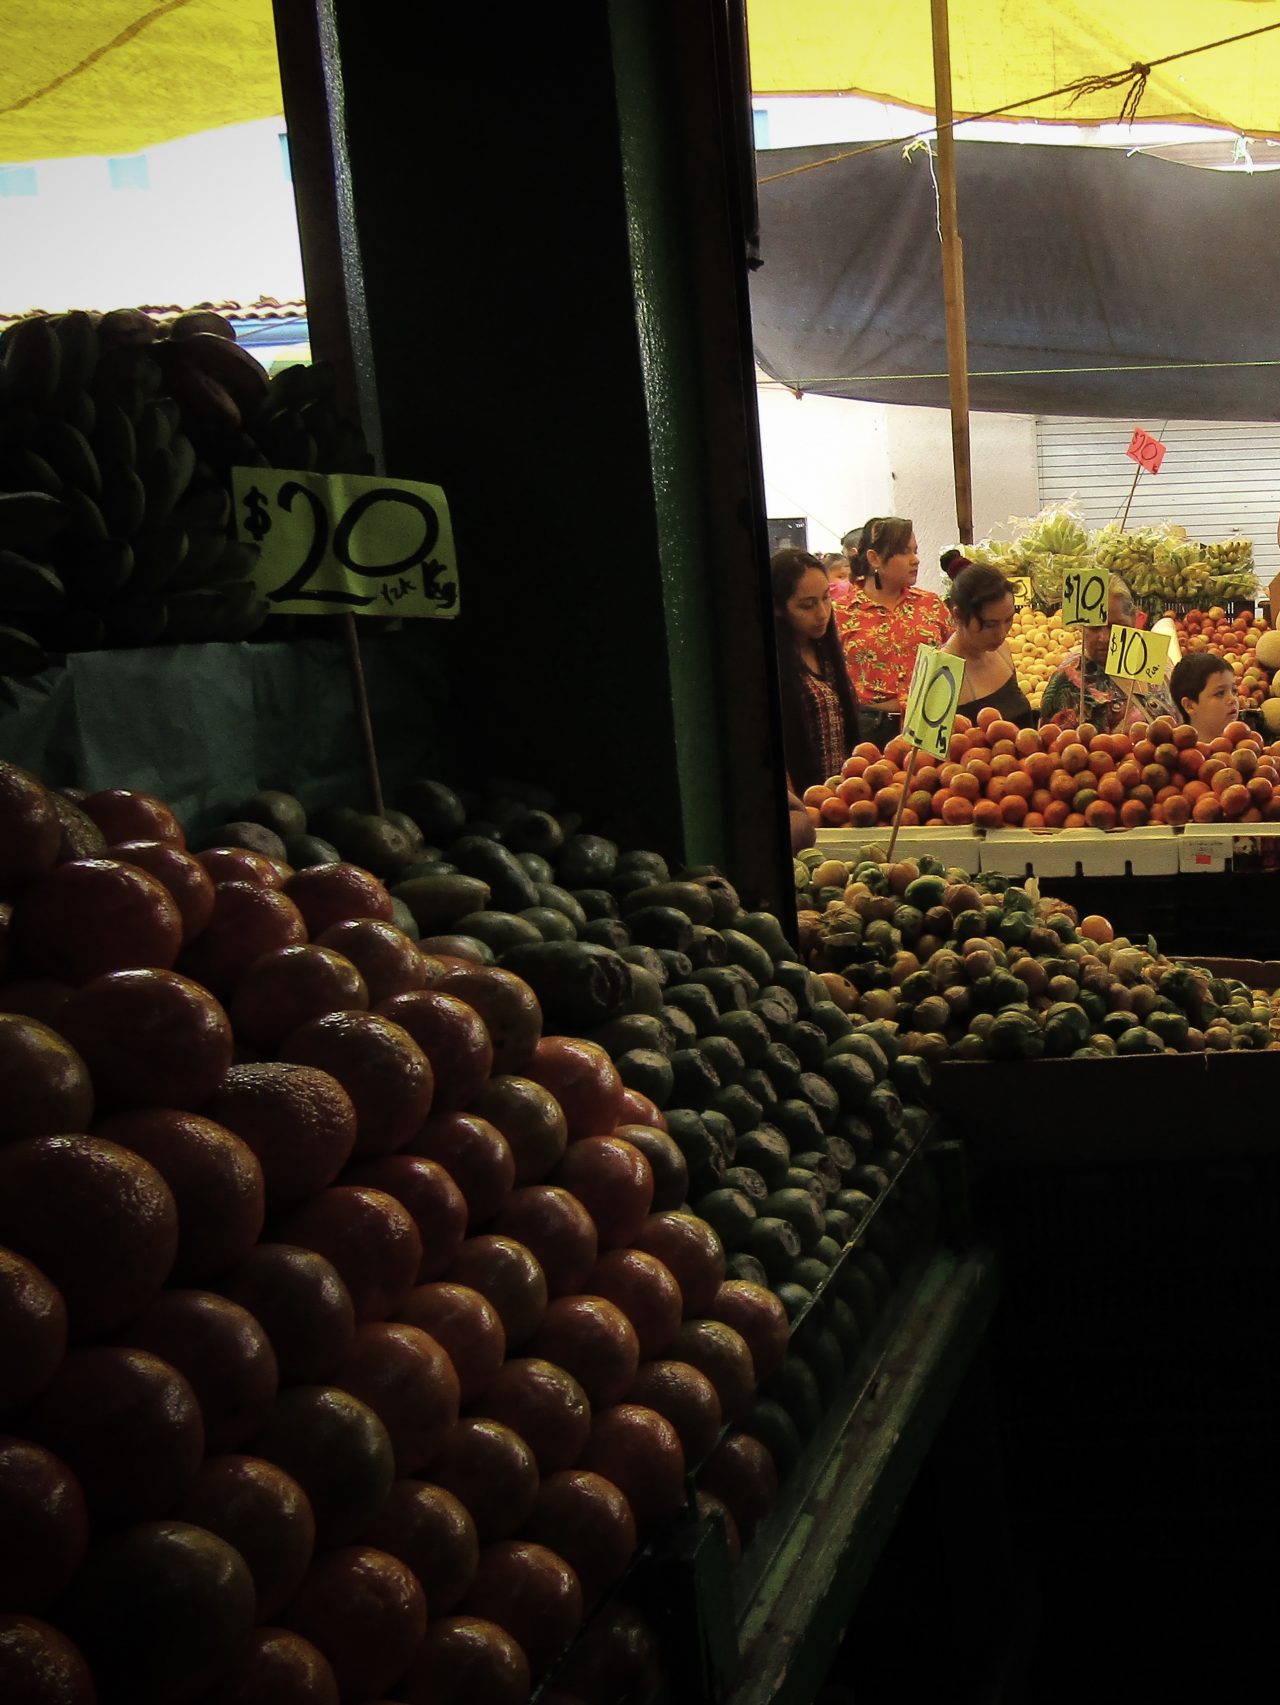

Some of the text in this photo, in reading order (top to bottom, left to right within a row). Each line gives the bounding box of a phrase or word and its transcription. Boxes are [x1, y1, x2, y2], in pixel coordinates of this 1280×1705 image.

[243, 480, 440, 606] $20
[1064, 573, 1105, 626] $10
[1110, 627, 1148, 676] $10
